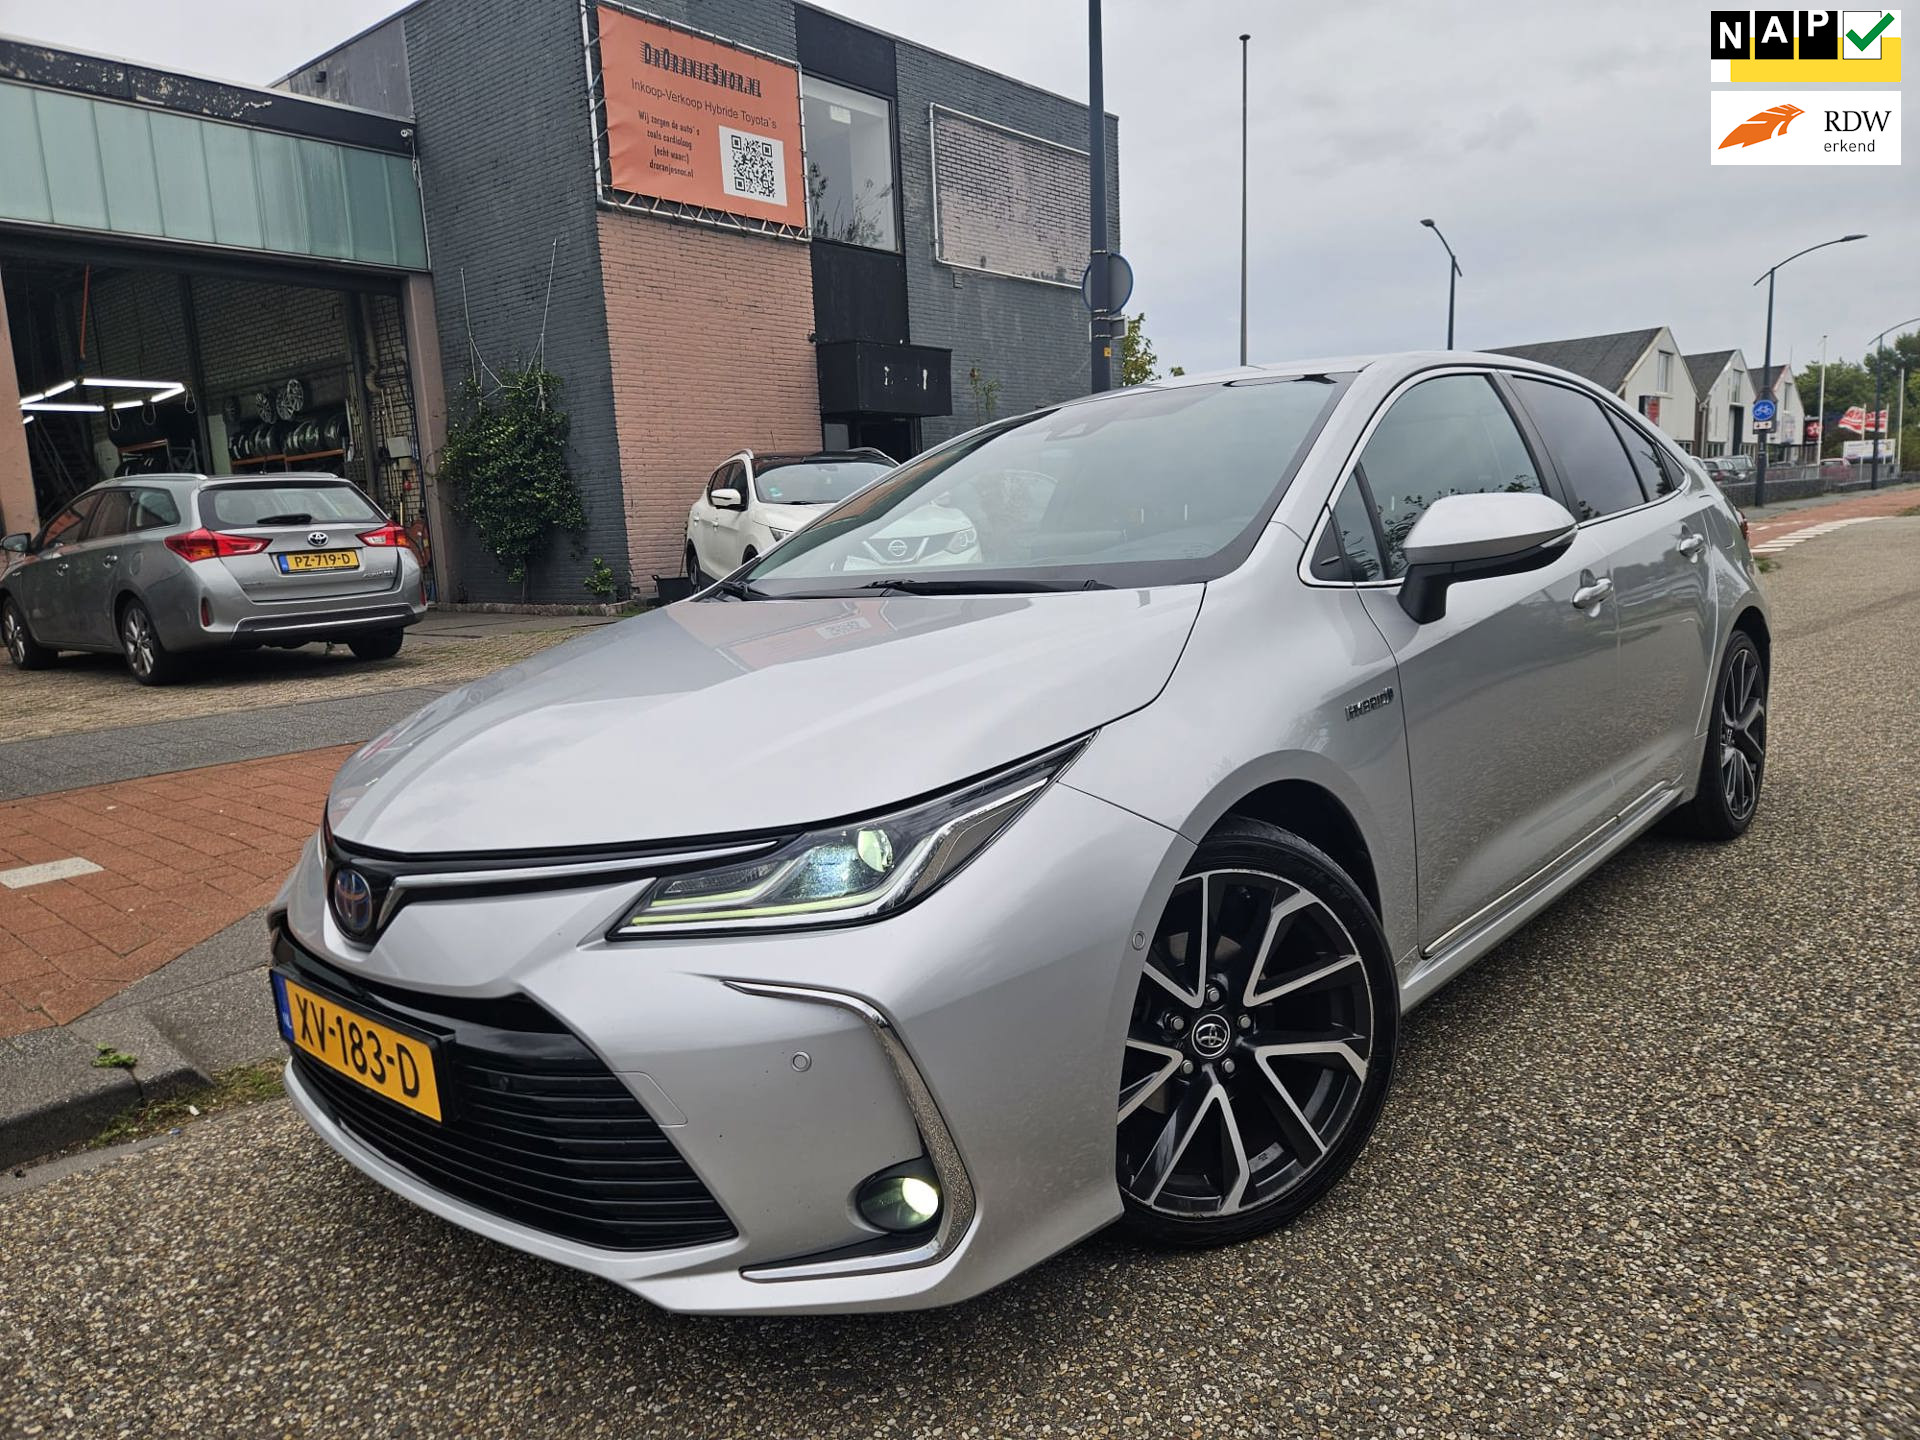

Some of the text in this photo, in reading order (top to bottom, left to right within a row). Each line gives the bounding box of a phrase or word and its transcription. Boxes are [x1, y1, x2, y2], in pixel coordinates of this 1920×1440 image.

[631, 78, 703, 111] Inkoop-Verkoop
[705, 101, 739, 120] Hybride
[638, 110, 650, 125] Wij
[651, 116, 670, 128] zorgen
[671, 120, 679, 130] de
[294, 553, 351, 568] PZ-719-D
[1344, 687, 1393, 721] HYBRID
[295, 993, 420, 1099] XV-183-D
